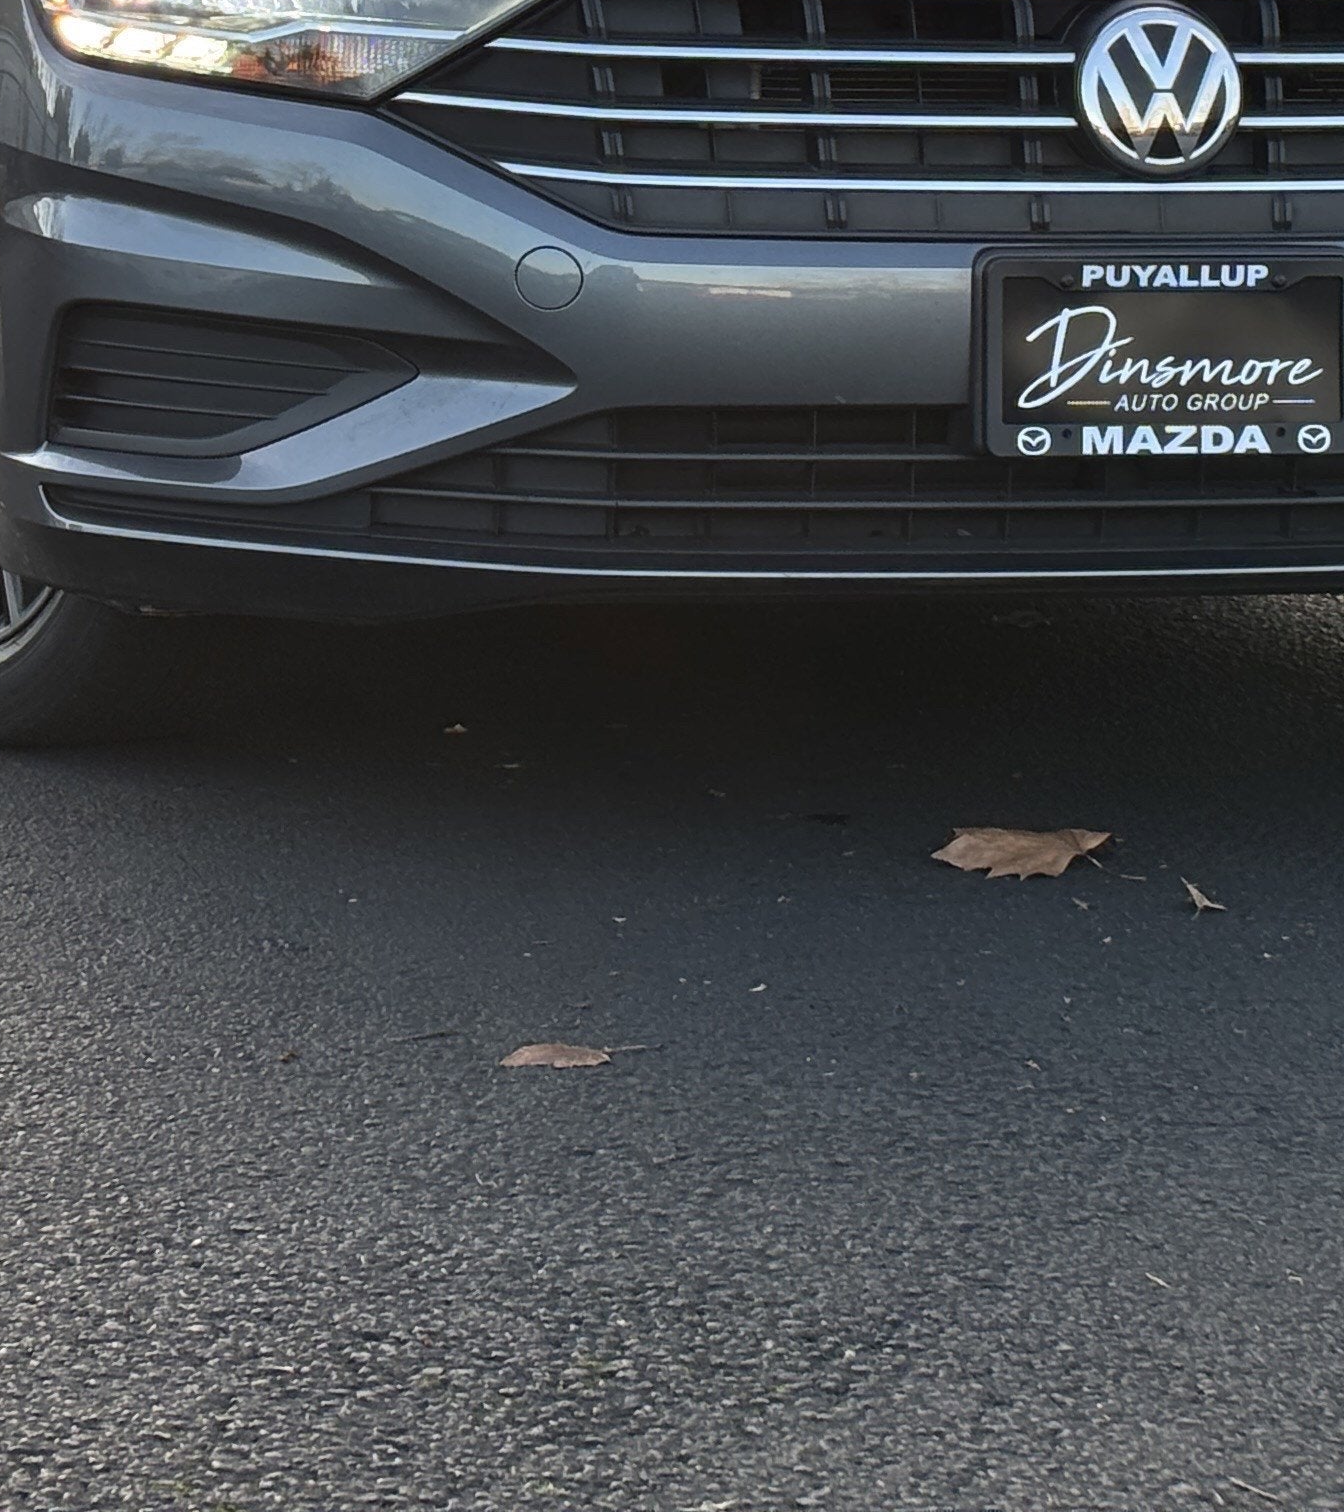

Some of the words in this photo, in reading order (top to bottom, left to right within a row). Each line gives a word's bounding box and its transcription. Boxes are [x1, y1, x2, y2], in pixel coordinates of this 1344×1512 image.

[1081, 6, 1241, 174] VW
[1081, 264, 1269, 288] PUYALLUP
[1016, 304, 1324, 410] Dinsmore
[1113, 393, 1179, 413] AUTO
[1186, 392, 1270, 412] GROUP
[1081, 425, 1272, 455] MAZDA
